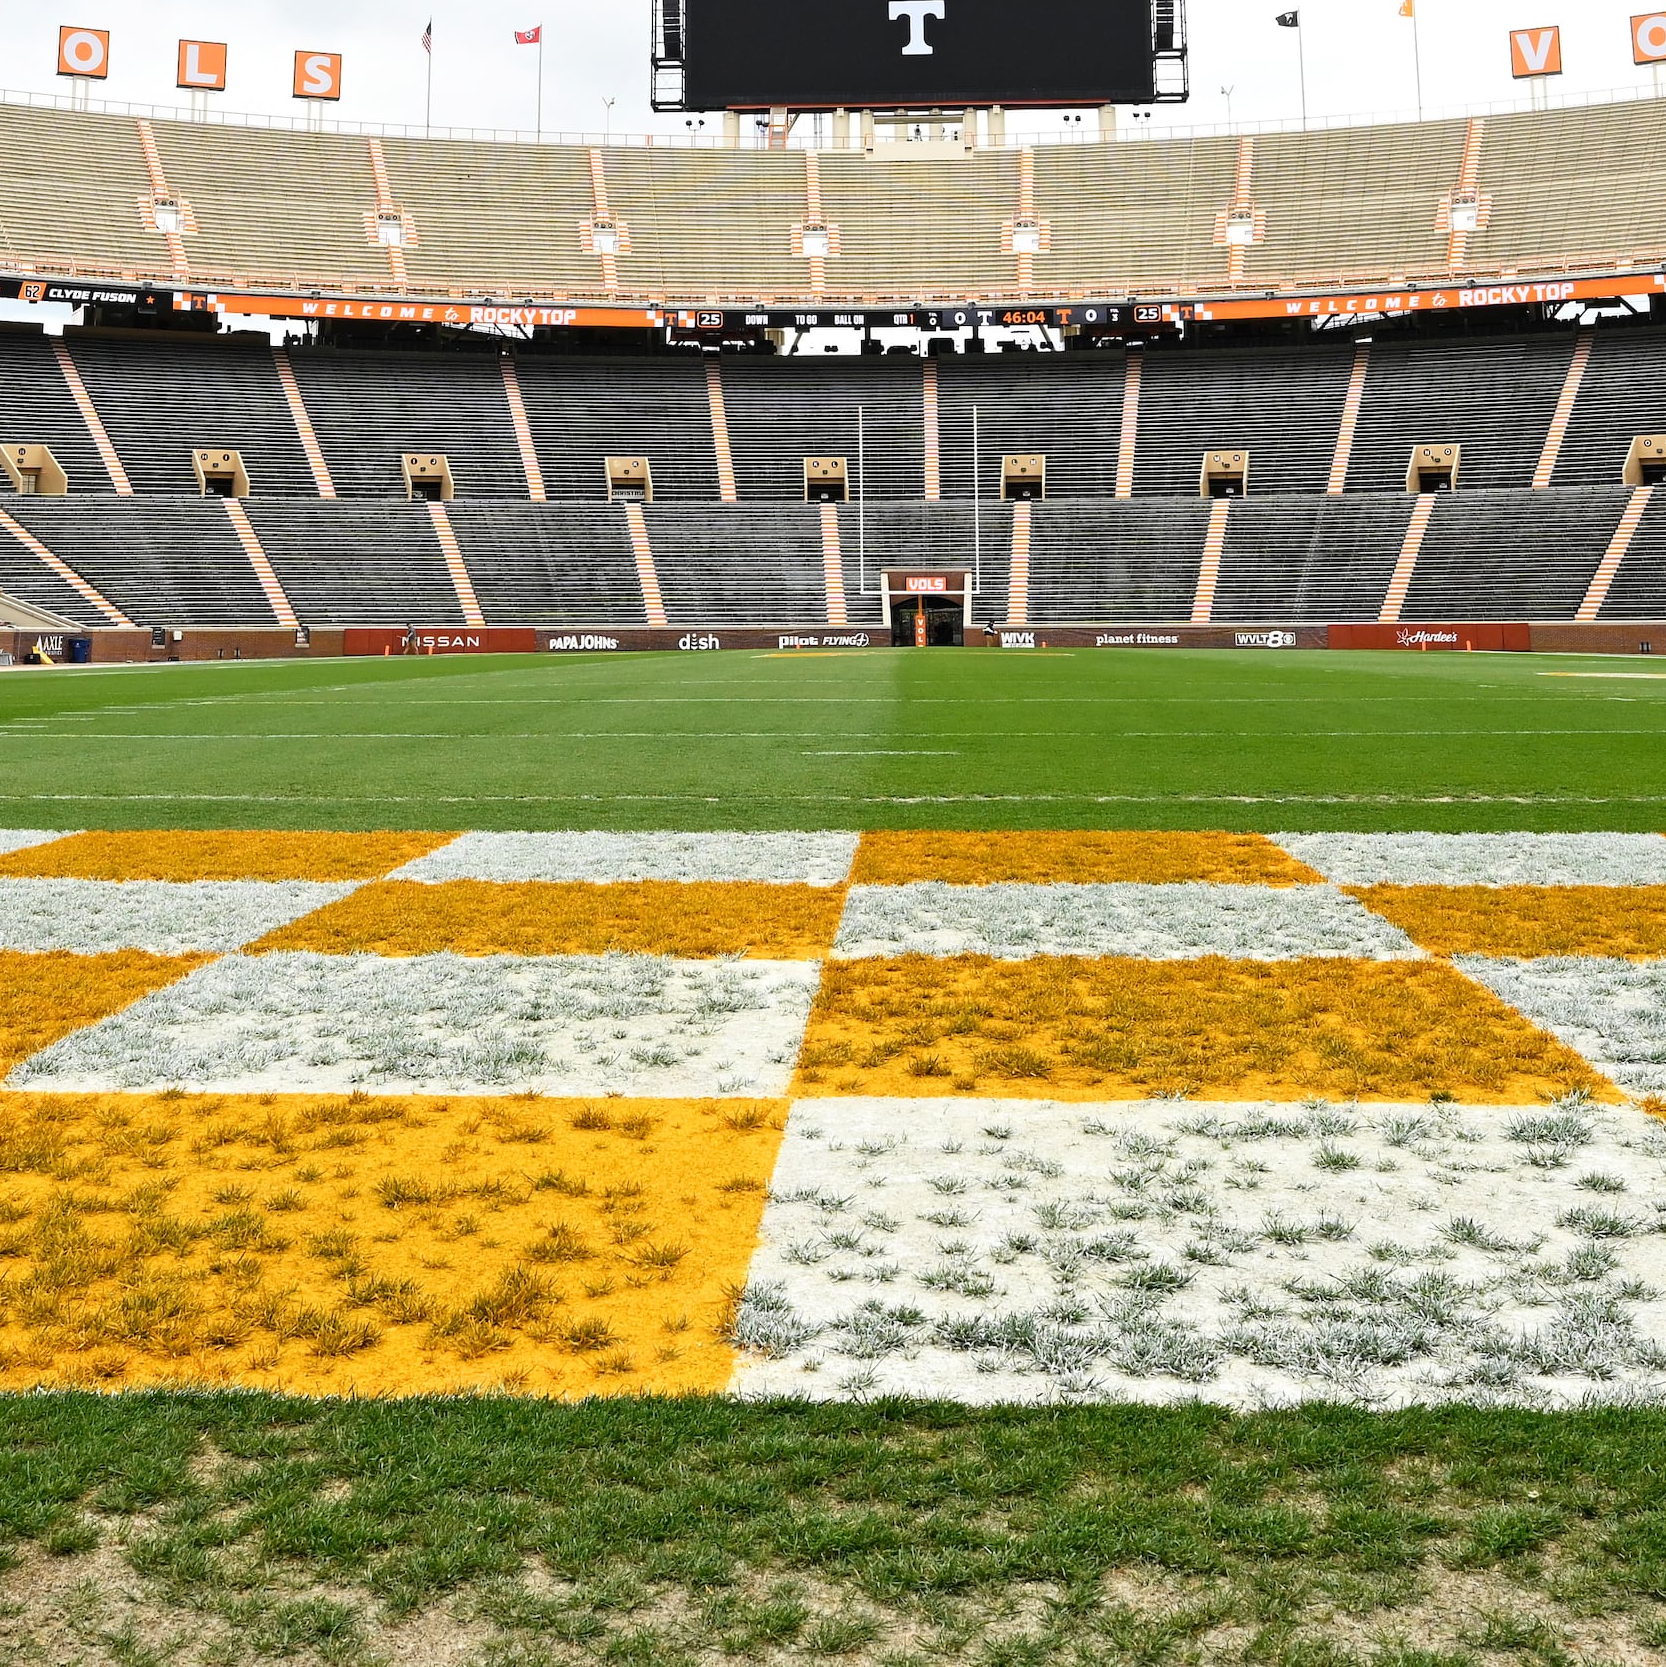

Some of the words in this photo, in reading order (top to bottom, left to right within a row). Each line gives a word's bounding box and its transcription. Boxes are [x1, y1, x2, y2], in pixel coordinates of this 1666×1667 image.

[888, 0, 946, 56] T
[24, 284, 40, 299] 62
[48, 288, 90, 300] CLYDE
[91, 292, 137, 304] FUSON
[1286, 295, 1420, 314] WELCOME
[1431, 292, 1448, 307] to
[1459, 285, 1530, 307] ROCKY
[1532, 282, 1574, 301] TOP
[302, 302, 434, 319] WELCOME
[444, 307, 460, 322] to
[470, 307, 536, 324] ROCKY
[539, 308, 576, 325] TOP
[700, 314, 720, 325] 25
[745, 314, 768, 325] DOWN
[795, 314, 805, 325] TO
[806, 314, 817, 325] GO
[834, 314, 852, 325] BALL
[853, 314, 864, 325] ON
[977, 311, 993, 326] T
[1003, 311, 1046, 324] 46:04
[1056, 309, 1072, 324] T
[1138, 308, 1158, 320] 25
[893, 314, 908, 326] QTR
[909, 579, 944, 590] VOLS
[402, 636, 480, 647] NISSAN
[679, 634, 719, 650] dish
[823, 637, 857, 646] FLYING
[1001, 633, 1035, 644] WIVK
[1096, 634, 1135, 646] planet
[1136, 634, 1177, 645] fitness
[1237, 634, 1268, 645] WVLT
[1268, 630, 1284, 648] 8
[1410, 631, 1458, 643] Hardee's
